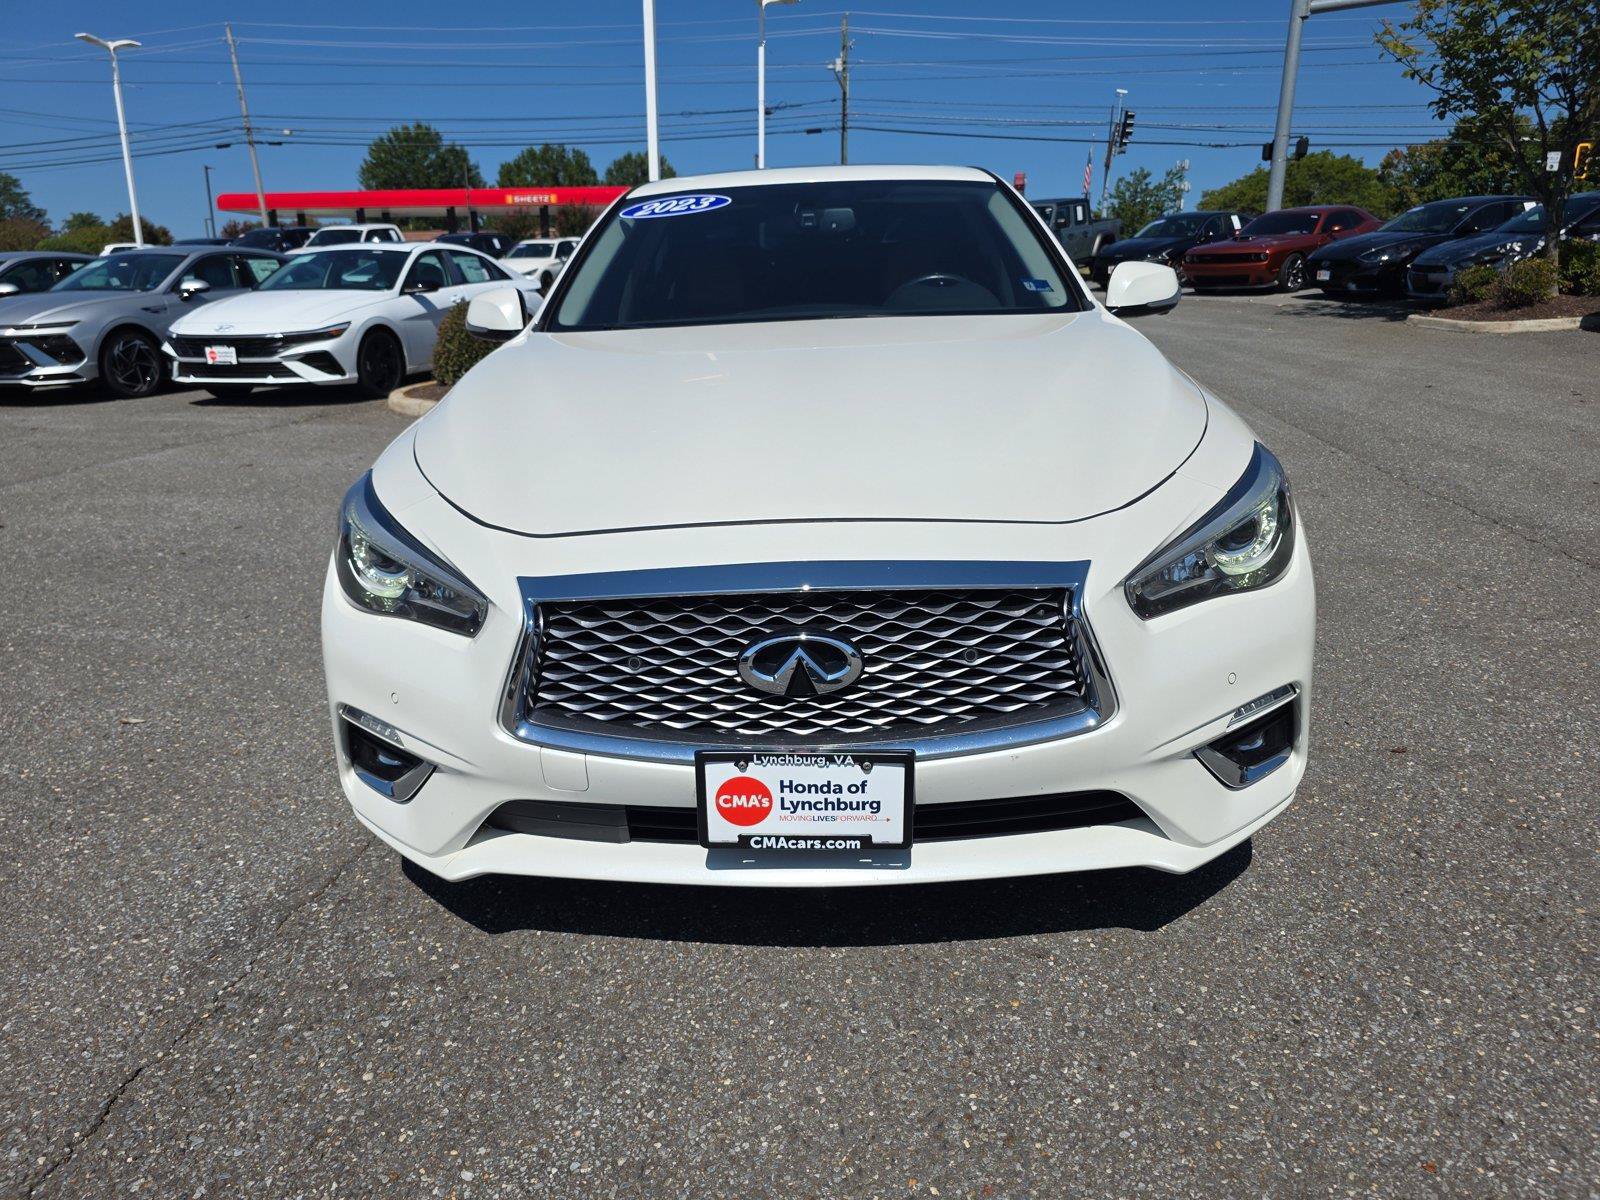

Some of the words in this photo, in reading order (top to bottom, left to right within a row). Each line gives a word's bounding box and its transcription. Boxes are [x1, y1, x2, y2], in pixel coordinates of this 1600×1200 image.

[633, 197, 716, 217] 2023
[753, 754, 830, 767] Lynchburg,
[834, 755, 855, 766] VA
[779, 780, 842, 794] Honda
[847, 780, 868, 794] of
[718, 793, 770, 808] CMA's
[780, 798, 881, 814] Lynchburg
[750, 837, 861, 850] CMAcars.com
